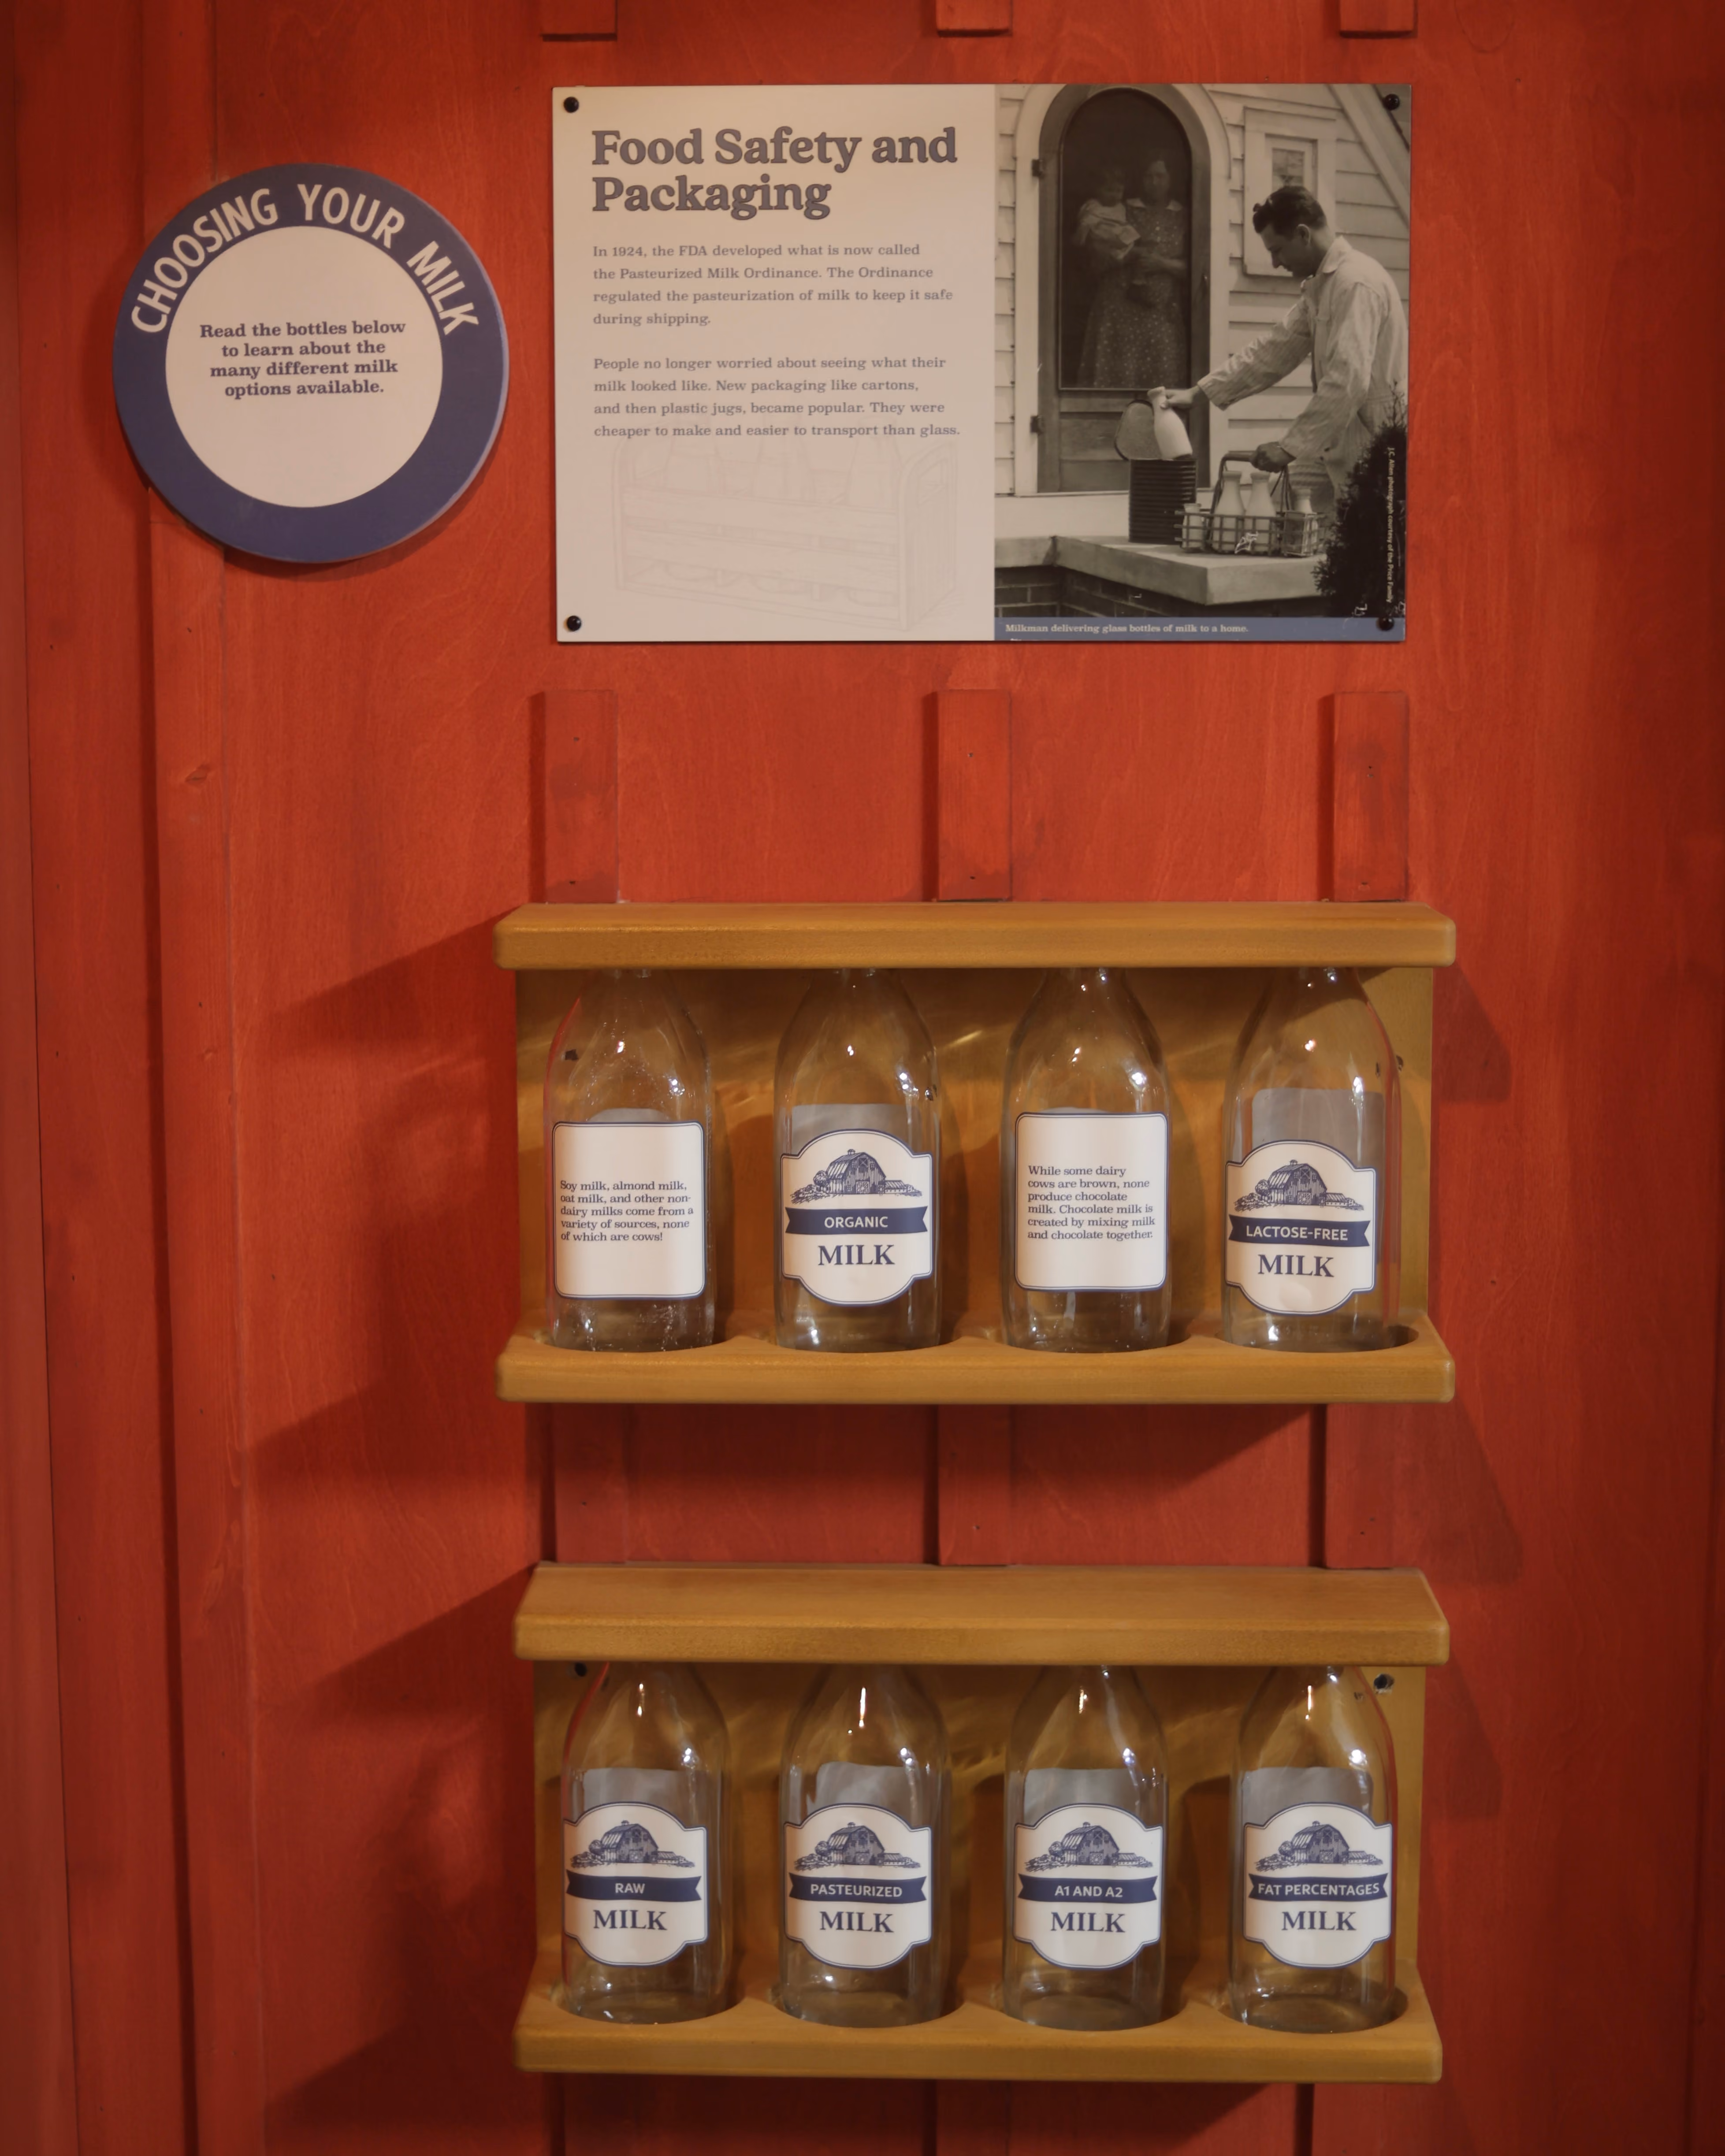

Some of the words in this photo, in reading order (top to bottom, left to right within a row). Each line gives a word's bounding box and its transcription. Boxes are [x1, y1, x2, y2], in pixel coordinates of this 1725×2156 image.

[592, 128, 704, 165] Food
[715, 126, 862, 173] Safety
[872, 127, 957, 163] and
[592, 174, 832, 220] Packaging
[594, 246, 607, 256] In
[613, 247, 647, 257] 1924,
[653, 245, 674, 256] the
[679, 245, 707, 256] FDA
[713, 245, 782, 258] developed
[788, 245, 822, 255] what
[828, 245, 839, 255] is
[878, 244, 920, 255] called
[131, 188, 278, 333] CHOOSING
[297, 184, 405, 249] YOUR
[406, 241, 479, 334] MILK
[594, 268, 615, 279] the
[621, 268, 702, 278] Pasteurized
[708, 268, 739, 278] Milk
[744, 267, 822, 278] Ordinance.
[827, 267, 854, 277] The
[859, 267, 933, 277] Ordinance
[594, 290, 661, 304] regulated
[666, 290, 688, 301] the
[693, 290, 794, 304] pasteurization
[799, 290, 813, 300] of
[818, 289, 850, 300] milk
[855, 291, 868, 300] to
[873, 289, 905, 303] keep
[910, 290, 919, 300] it
[925, 289, 952, 300] safe
[593, 314, 642, 326] during
[647, 313, 710, 327] shipping.
[200, 323, 246, 338] Read
[252, 323, 281, 336] the
[286, 322, 347, 335] bottles
[352, 320, 405, 334] below
[222, 345, 238, 357] to
[244, 343, 294, 356] learn
[300, 341, 350, 355] about
[357, 340, 385, 353] the
[211, 367, 260, 379] many
[267, 361, 349, 375] different
[355, 360, 398, 373] milk
[594, 358, 639, 371] People
[666, 358, 711, 371] longer
[717, 357, 772, 368] worried
[777, 357, 816, 368] about
[821, 357, 866, 370] seeing
[871, 357, 906, 367] what
[912, 357, 946, 367] their
[225, 382, 291, 400] options
[297, 379, 383, 394] available.
[595, 381, 626, 391] milk
[632, 380, 677, 391] looked
[682, 380, 710, 390] like.
[716, 381, 746, 390] New
[751, 380, 826, 393] packaging
[832, 379, 857, 390] like
[862, 381, 918, 391] cartons,
[595, 403, 620, 413] and
[626, 403, 656, 413] then
[662, 403, 707, 416] plastic
[711, 403, 746, 416] jugs,
[751, 402, 803, 413] became
[808, 402, 864, 416] popular.
[870, 402, 905, 415] They
[595, 426, 651, 439] cheaper
[655, 427, 668, 436] to
[673, 425, 711, 435] make
[716, 425, 741, 435] and
[747, 425, 789, 435] easier
[794, 427, 807, 435] to
[812, 426, 878, 438] transport
[883, 424, 915, 435] than
[920, 424, 960, 437] glass.
[1051, 624, 1100, 634] delivering
[1102, 624, 1127, 633] glass
[1029, 1165, 1060, 1175] While
[1096, 1166, 1126, 1177] dairy
[561, 1180, 577, 1192] Soy
[581, 1181, 609, 1191] milk,
[613, 1181, 655, 1190] almond
[658, 1181, 686, 1190] milk,
[1080, 1179, 1119, 1188] brown,
[578, 1194, 606, 1203] milk,
[610, 1194, 631, 1202] and
[635, 1194, 664, 1202] other
[1028, 1192, 1072, 1202] produce
[1075, 1192, 1127, 1201] chocolate
[561, 1206, 587, 1217] dairy
[591, 1207, 622, 1216] milks
[658, 1206, 684, 1215] from
[1028, 1205, 1056, 1213] milk.
[1060, 1204, 1113, 1213] Chocolate
[1117, 1205, 1141, 1213] milk
[1145, 1204, 1152, 1213] is
[561, 1220, 598, 1231] variety
[601, 1219, 612, 1228] of
[825, 1217, 888, 1228] ORGANIC
[1028, 1217, 1068, 1226] created
[1071, 1217, 1084, 1228] by
[1088, 1217, 1128, 1228] mixing
[1132, 1217, 1155, 1226] milk
[561, 1232, 570, 1240] of
[573, 1232, 606, 1241] which
[632, 1232, 662, 1241] cows!
[1028, 1230, 1048, 1239] and
[1051, 1230, 1103, 1239] chocolate
[1107, 1230, 1152, 1241] together.
[1247, 1225, 1348, 1240] LACTOSE-FREE
[818, 1245, 895, 1265] MILK
[1258, 1254, 1334, 1277] MILK
[615, 1883, 645, 1893] RAW
[811, 1884, 902, 1897] PASTEURIZED
[1055, 1885, 1069, 1896] A1
[1073, 1886, 1102, 1896] AND
[1105, 1887, 1123, 1897] A2
[1259, 1884, 1282, 1895] FAT
[1285, 1883, 1379, 1895] PERCENTAGES
[594, 1910, 667, 1930] MILK
[820, 1911, 893, 1932] MILK
[1051, 1912, 1125, 1932] MILK
[1282, 1911, 1356, 1930] MILK
